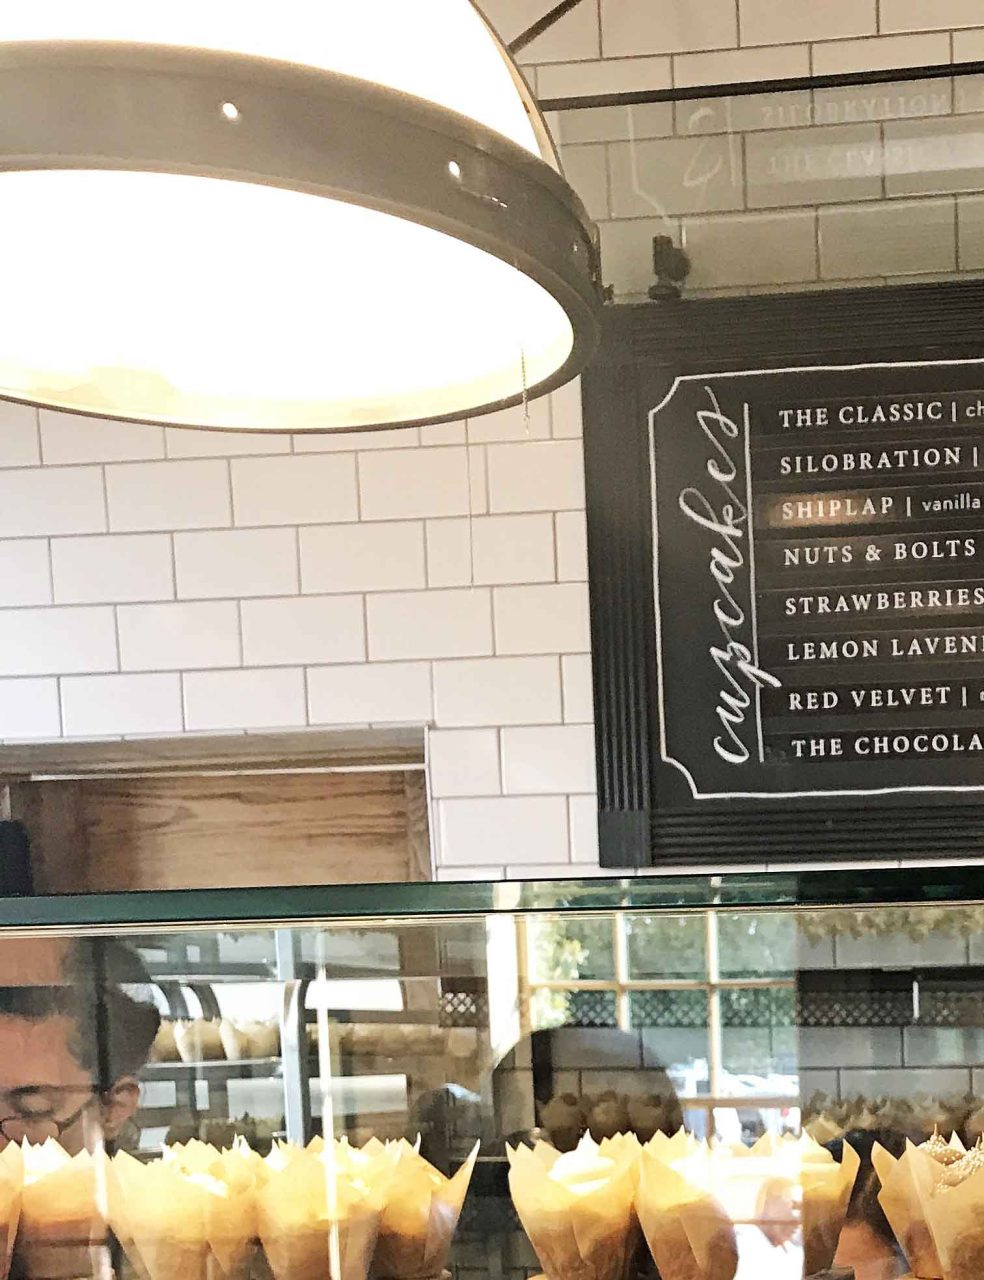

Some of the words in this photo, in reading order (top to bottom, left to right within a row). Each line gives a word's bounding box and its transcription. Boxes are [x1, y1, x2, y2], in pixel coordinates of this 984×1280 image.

[779, 408, 828, 427] THE
[839, 401, 943, 424] CLASSIC
[781, 446, 961, 474] SILOBRATION
[783, 496, 893, 521] SHIPLAP
[922, 493, 981, 512] vanilla
[784, 545, 852, 565] NUTS
[865, 545, 882, 562] &
[894, 539, 975, 561] BOLTS
[679, 386, 782, 764] cupcakes
[786, 586, 984, 616] STRAWBERRIES
[788, 639, 878, 661] LEMON
[789, 691, 838, 710] RED
[850, 687, 950, 707] VELVET
[791, 738, 843, 757] THE
